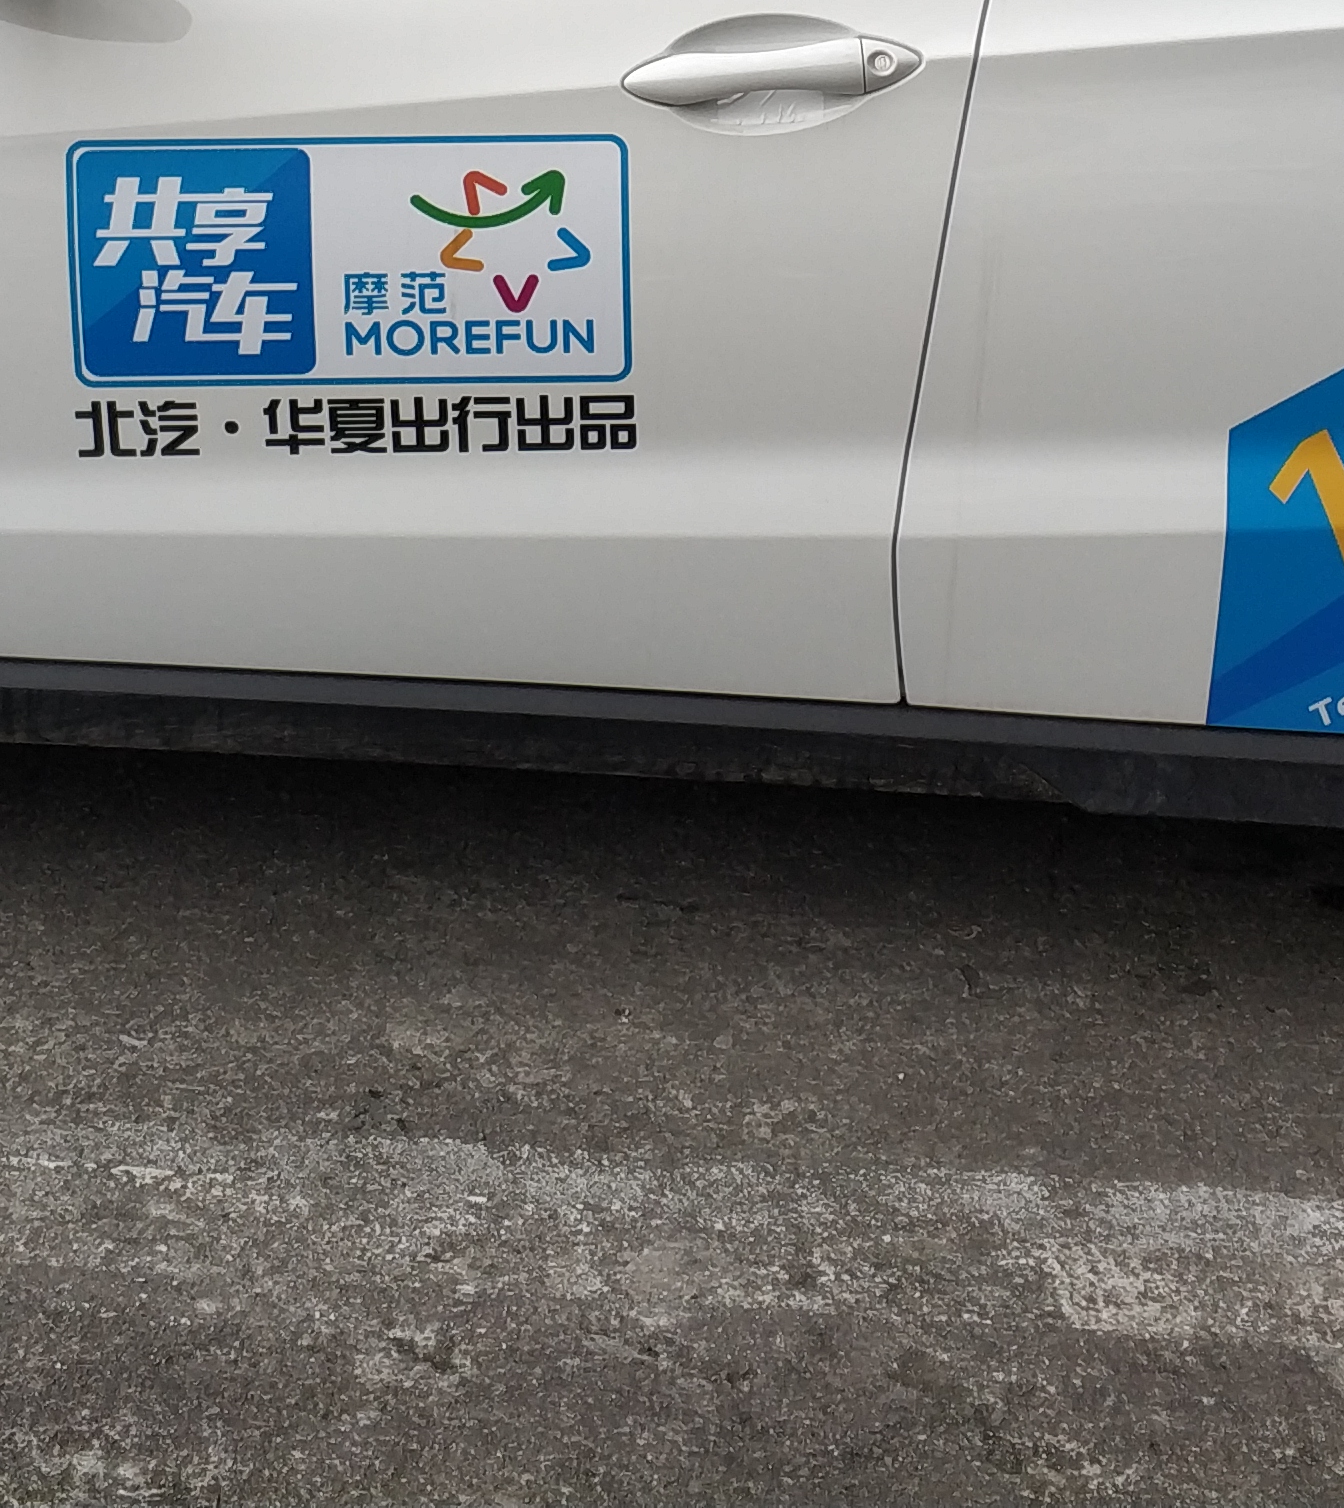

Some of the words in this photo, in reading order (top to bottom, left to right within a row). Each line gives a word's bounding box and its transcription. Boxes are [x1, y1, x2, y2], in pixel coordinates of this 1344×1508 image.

[92, 176, 273, 267] 共享
[132, 269, 298, 356] 汽车
[343, 271, 447, 316] 摩范
[344, 319, 595, 357] MOREFUN
